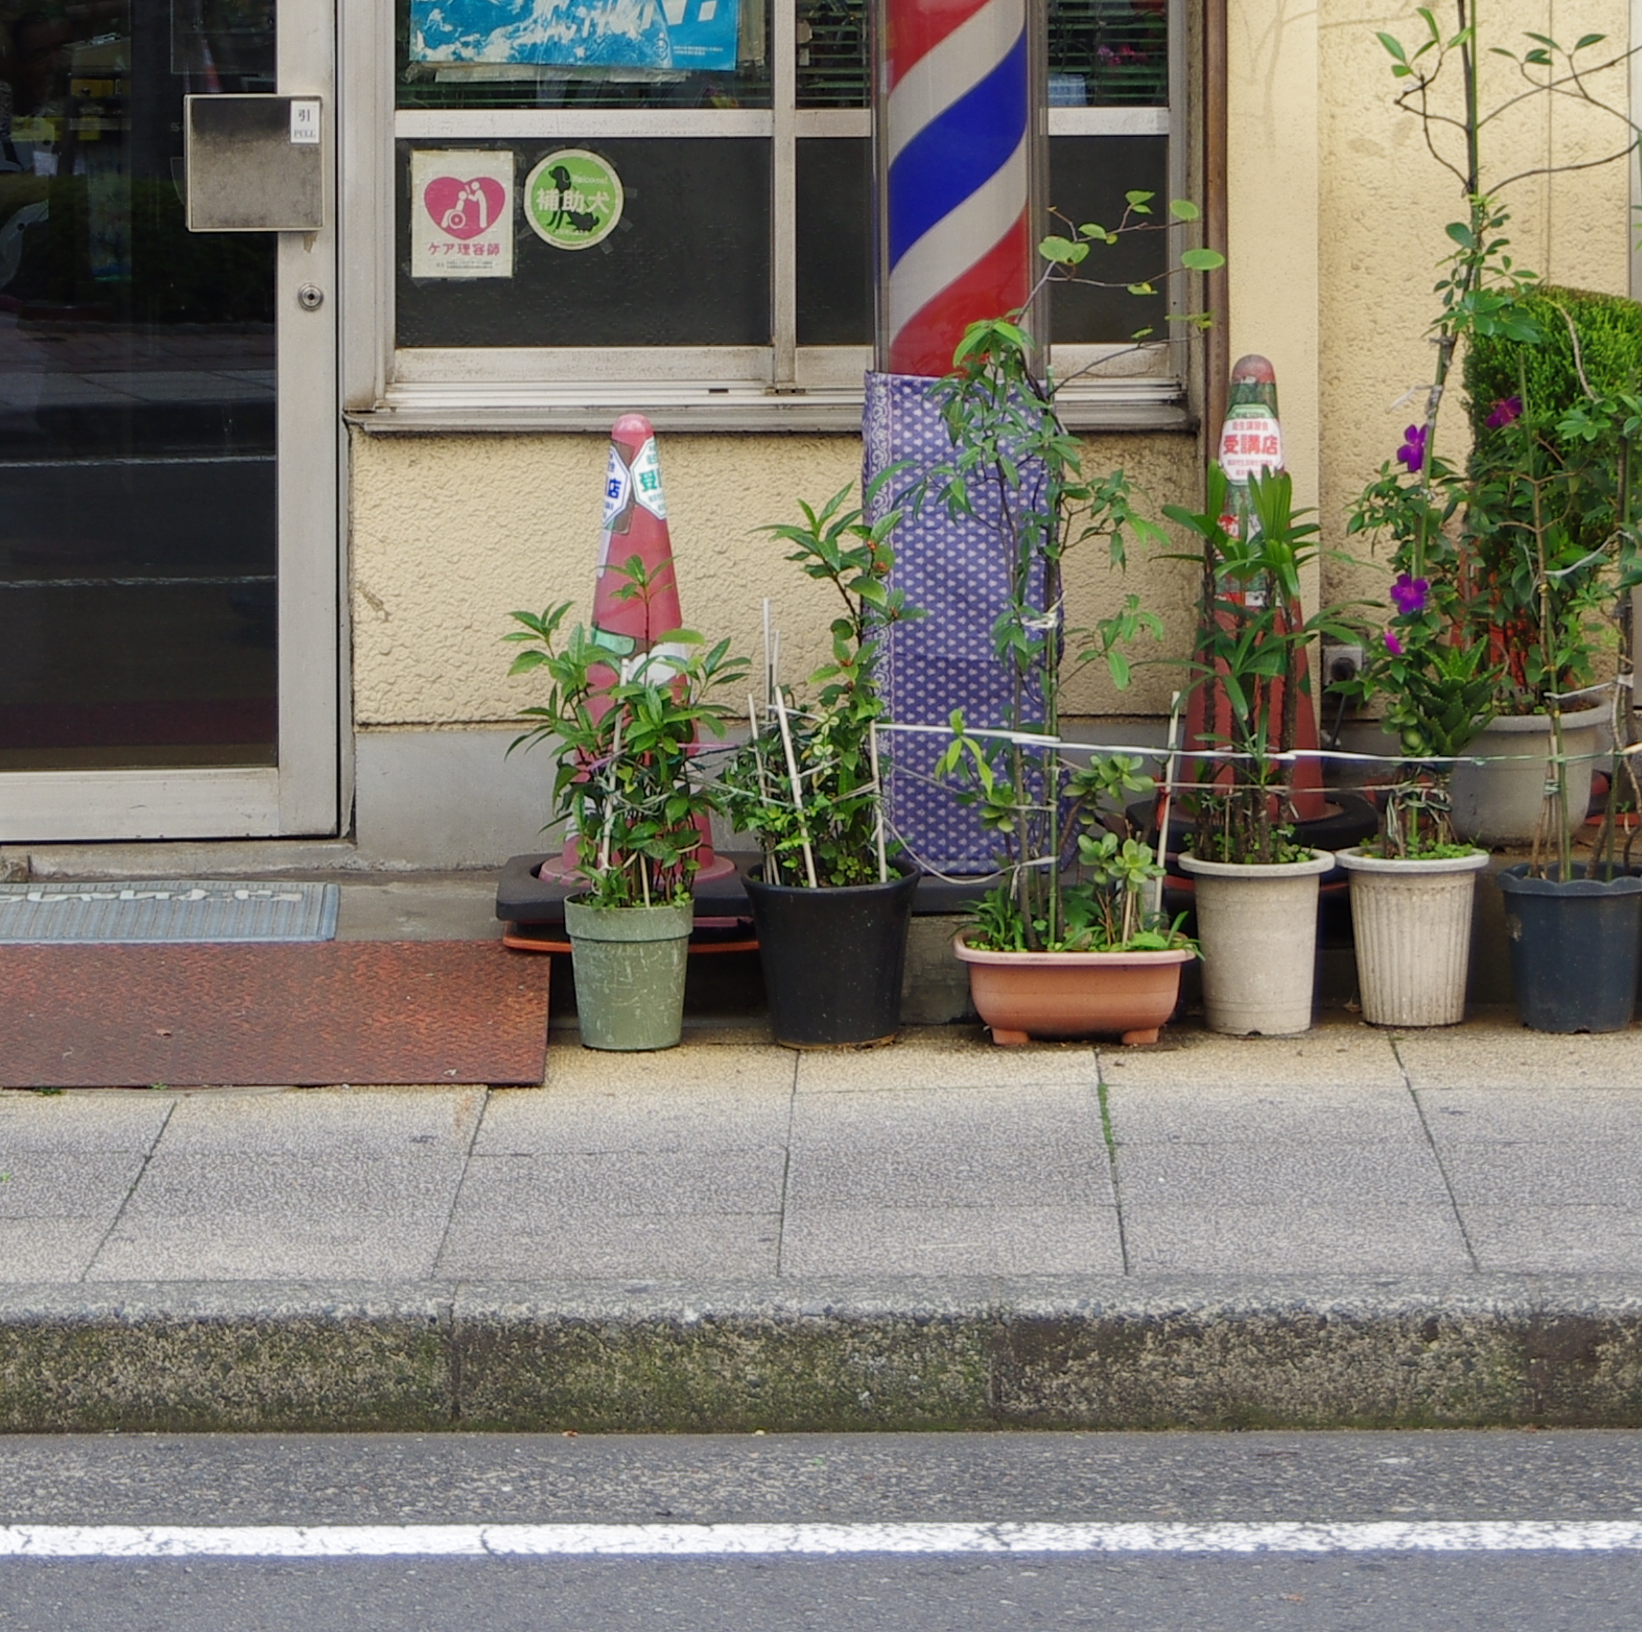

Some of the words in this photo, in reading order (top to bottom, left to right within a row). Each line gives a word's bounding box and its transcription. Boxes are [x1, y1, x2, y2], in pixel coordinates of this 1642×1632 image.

[536, 187, 610, 214] 補助犬
[428, 241, 500, 257] ケア理容師
[1223, 433, 1278, 456] 受講店
